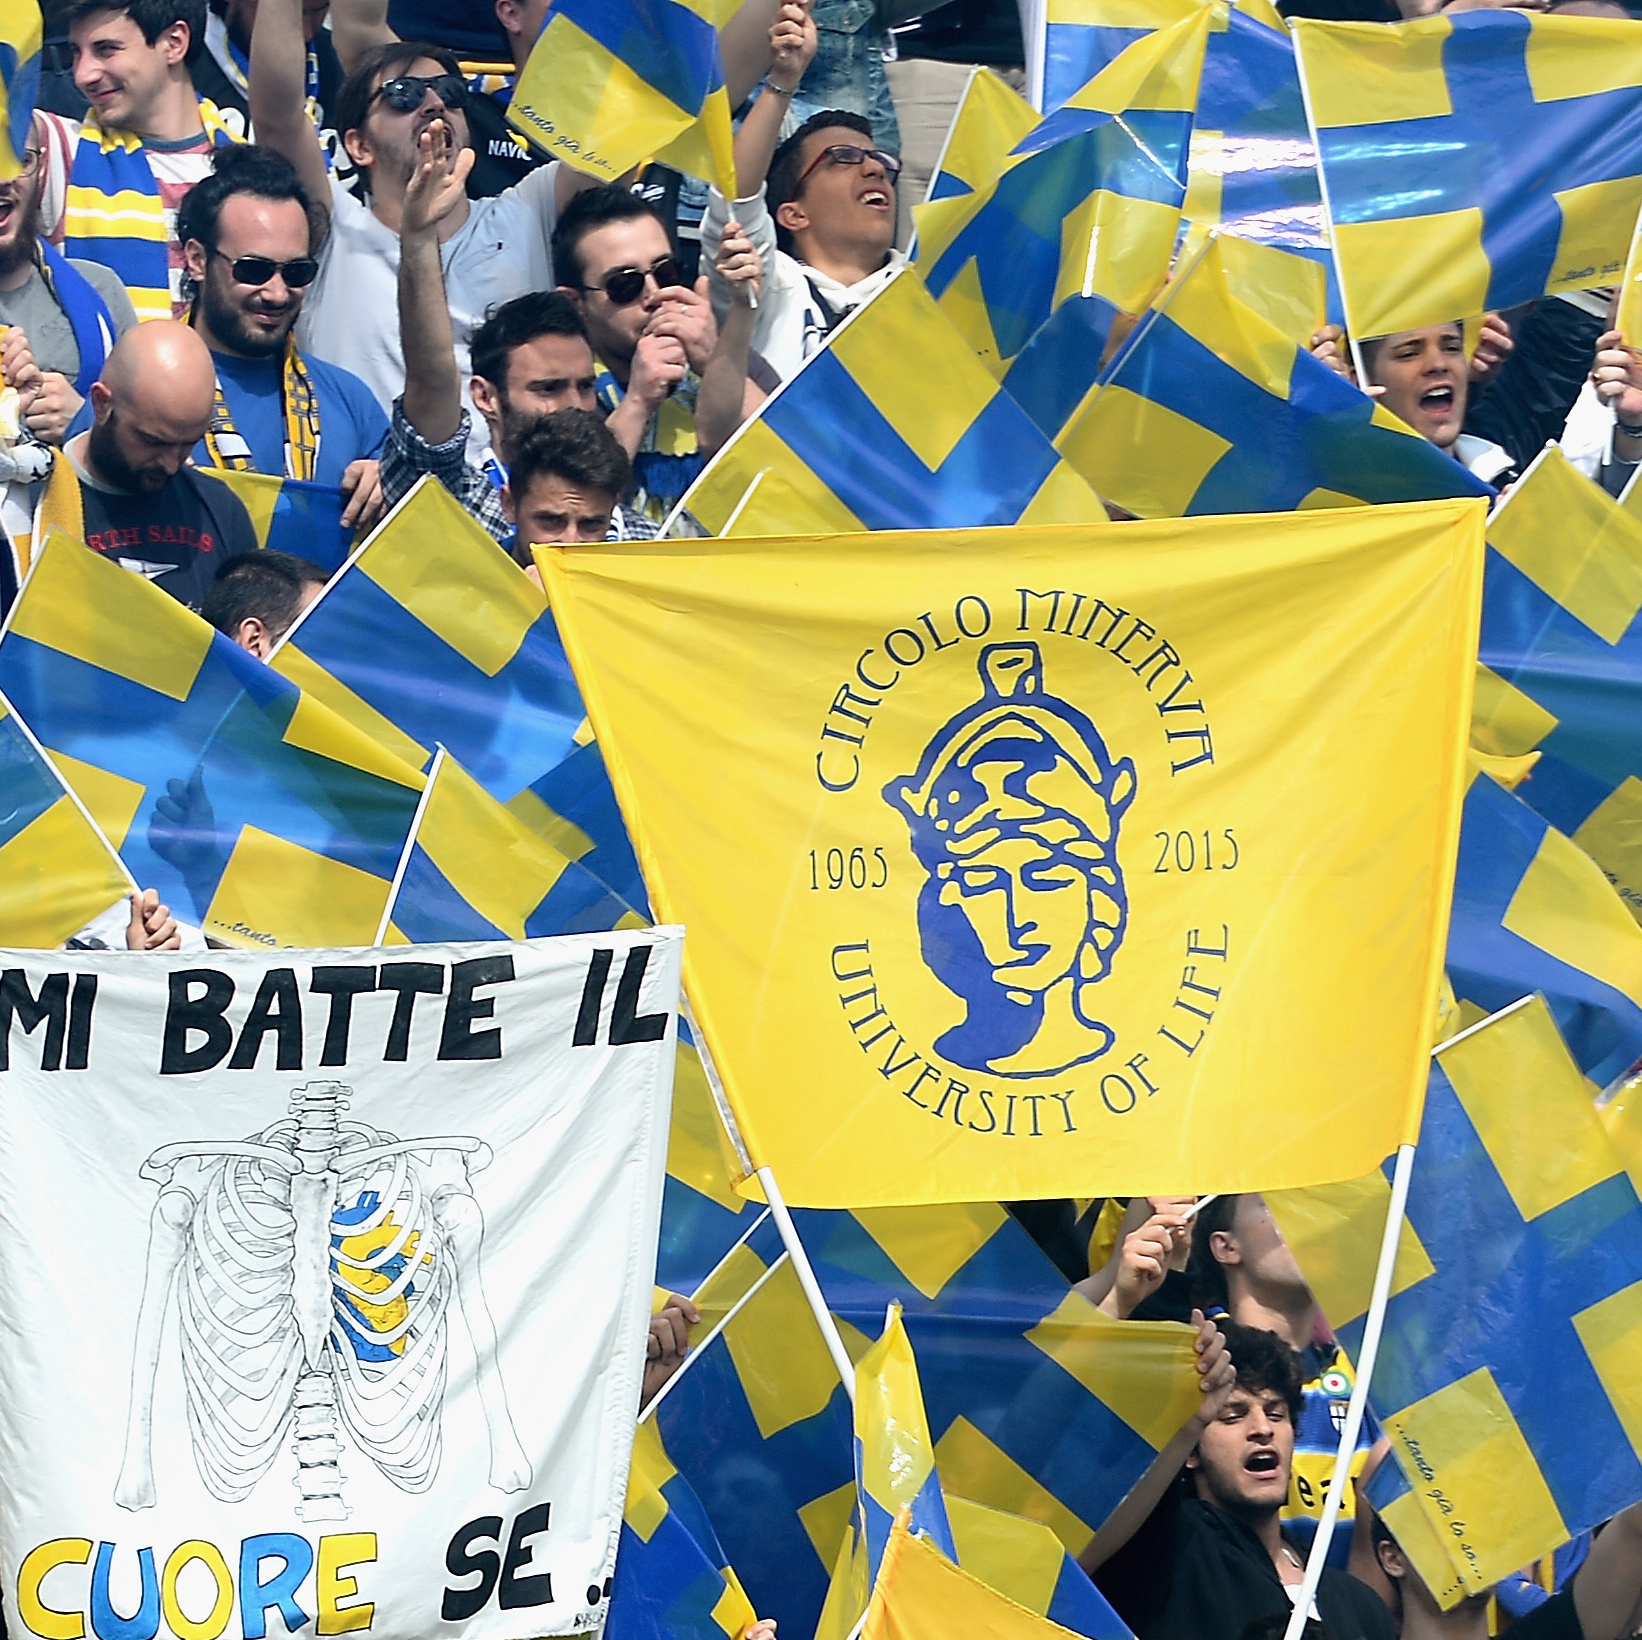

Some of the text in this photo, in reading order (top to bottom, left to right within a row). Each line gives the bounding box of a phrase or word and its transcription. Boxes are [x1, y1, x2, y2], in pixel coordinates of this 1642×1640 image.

[146, 524, 215, 554] SAILS
[816, 588, 1216, 793] CIRCOLO MINERVA
[808, 846, 889, 891] 1965
[1154, 828, 1241, 874] 2015
[214, 919, 278, 946] ...tanto
[159, 954, 517, 1076] BATTE
[571, 944, 670, 1049] IL
[830, 922, 1230, 1137] UNIVERSITY OF LIFE
